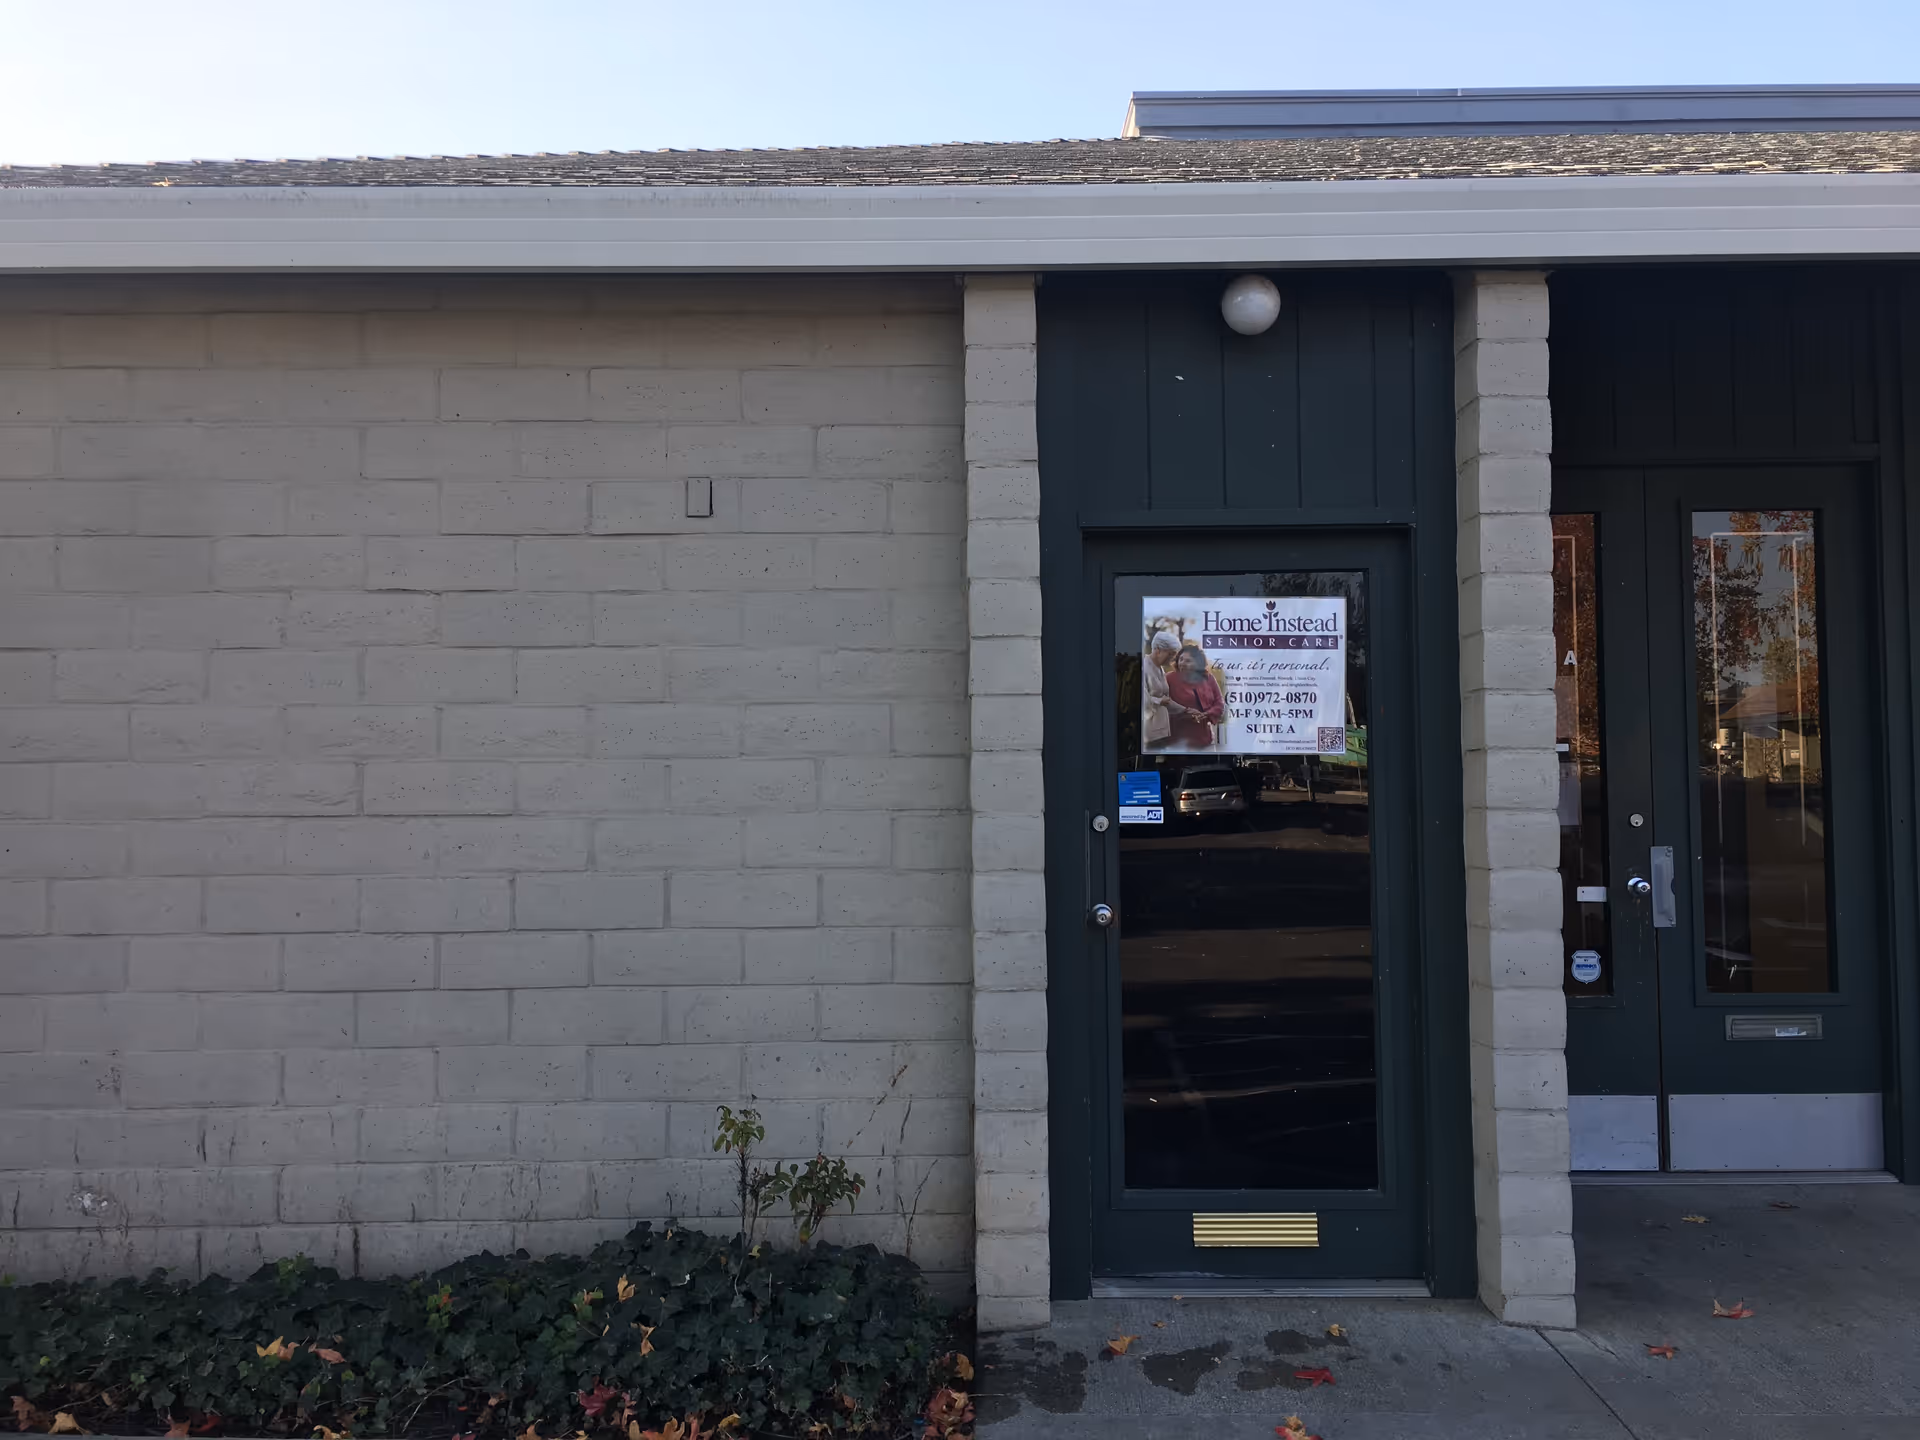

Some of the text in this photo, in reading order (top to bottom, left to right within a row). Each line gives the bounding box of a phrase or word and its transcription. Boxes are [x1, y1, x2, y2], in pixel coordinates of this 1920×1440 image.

[1202, 610, 1338, 632] Home Instead
[1205, 637, 1335, 647] SENIOR CARE
[1563, 650, 1577, 665] A
[1211, 658, 1224, 670] To
[1247, 658, 1266, 670] it's
[1268, 657, 1330, 673] personal.
[1224, 691, 1317, 706] (510)972-0870
[1229, 708, 1314, 719] M-F 9AM~5PM
[1246, 723, 1296, 734] SUITE A
[1147, 811, 1162, 819] ADT
